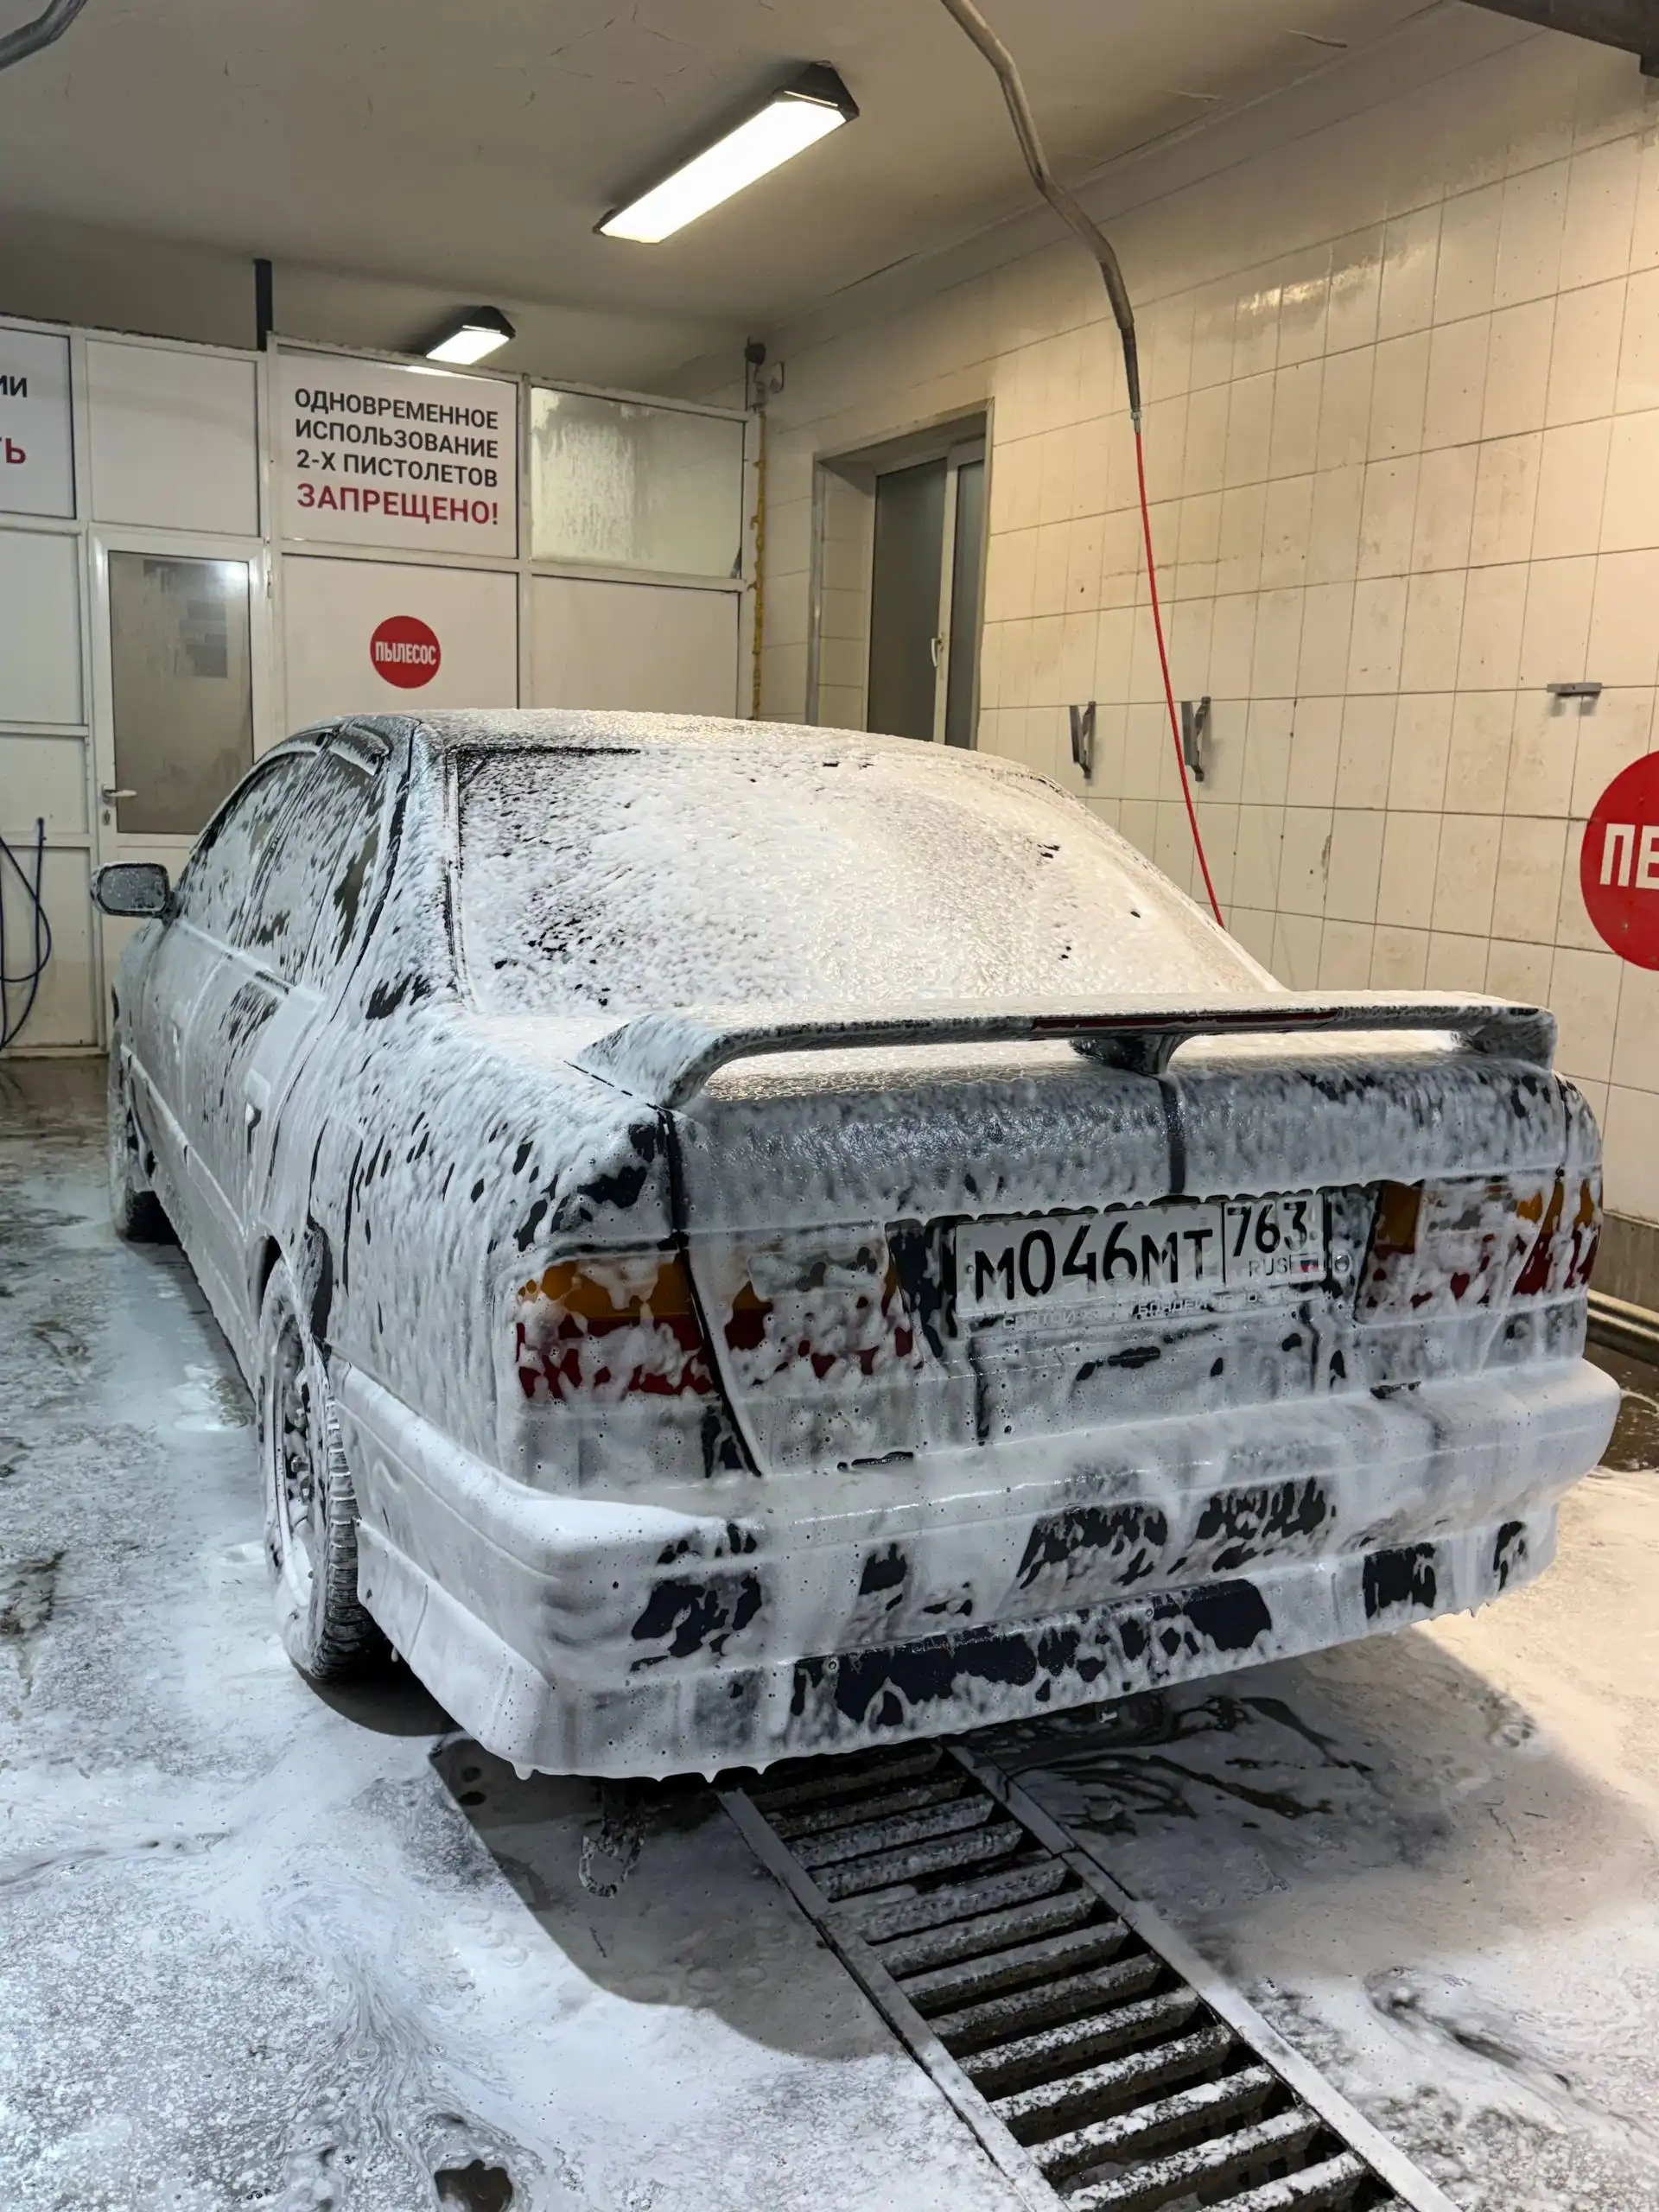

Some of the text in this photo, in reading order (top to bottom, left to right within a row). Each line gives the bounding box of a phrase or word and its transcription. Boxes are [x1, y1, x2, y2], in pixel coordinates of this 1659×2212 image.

[295, 388, 499, 429] ОДНОВРЕМЕННОЕ
[0, 436, 27, 464] Ь
[296, 418, 499, 459] ИСПОЛЬЗОВАНИЕ
[296, 448, 498, 488] 2-Х ПИСТОЛЕТОВ
[297, 483, 499, 525] ЗАПРЕЩЕНО!
[375, 640, 436, 665] ПЫЛЕСОС
[1599, 823, 1659, 890] ПЕ
[1227, 1200, 1307, 1257] 763
[1249, 1257, 1287, 1277] RUS
